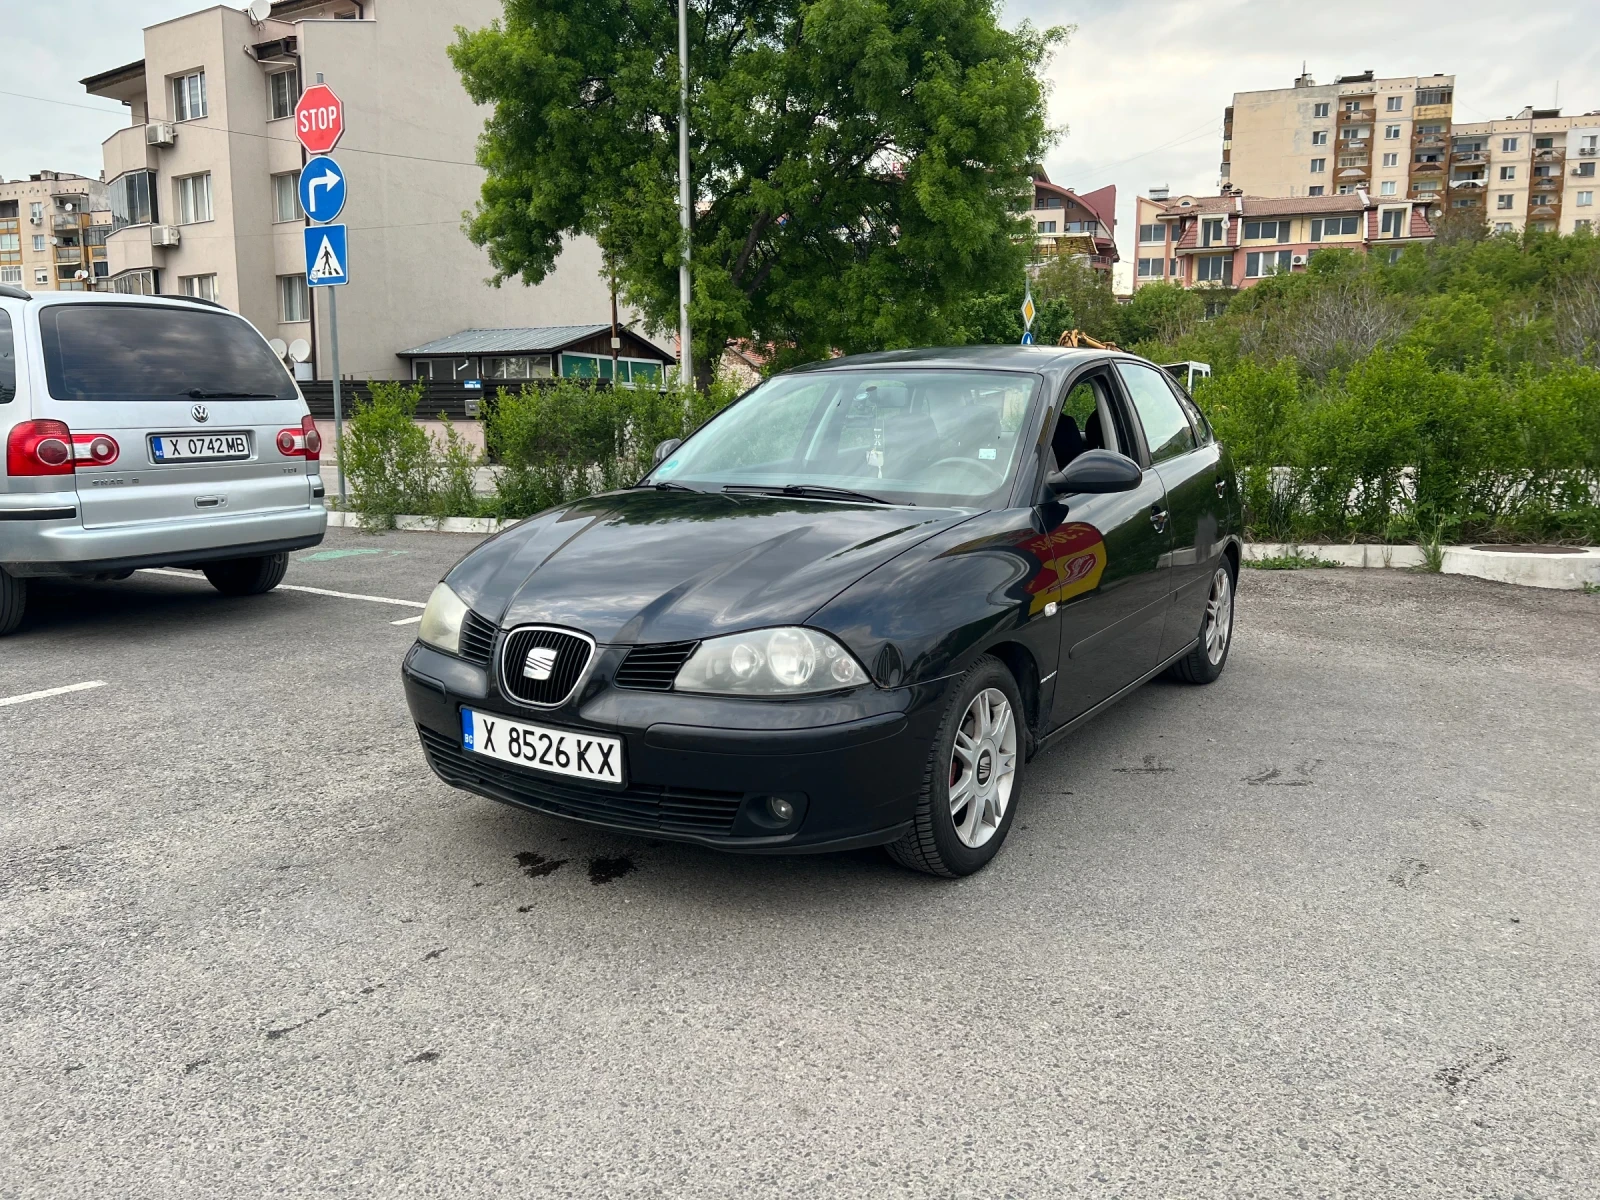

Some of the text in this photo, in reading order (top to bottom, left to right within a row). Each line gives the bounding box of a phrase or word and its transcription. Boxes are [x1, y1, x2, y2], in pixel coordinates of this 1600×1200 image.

[299, 106, 337, 133] STOP
[170, 439, 181, 455] X
[464, 734, 473, 744] BG
[482, 719, 496, 753] X
